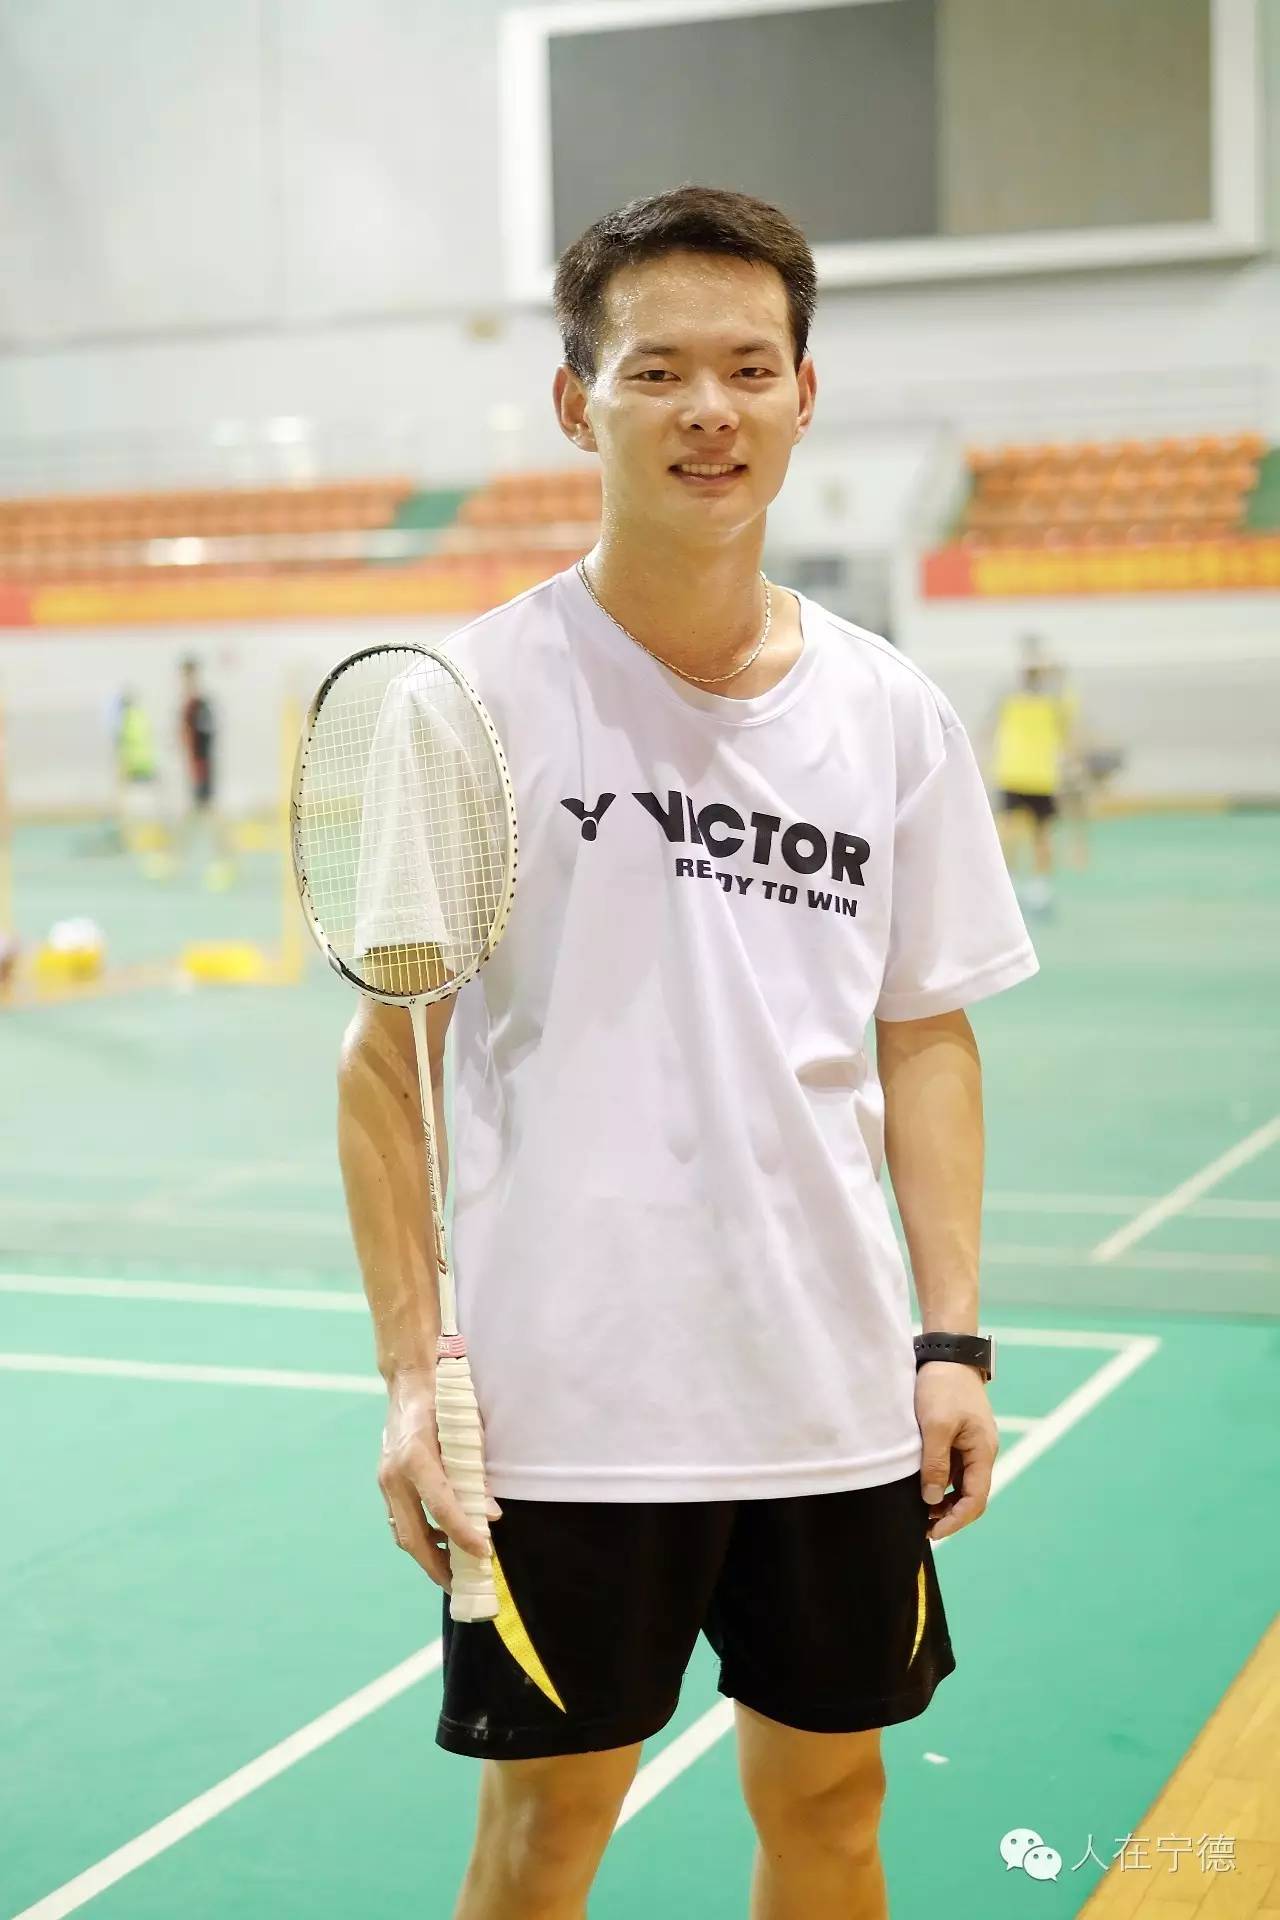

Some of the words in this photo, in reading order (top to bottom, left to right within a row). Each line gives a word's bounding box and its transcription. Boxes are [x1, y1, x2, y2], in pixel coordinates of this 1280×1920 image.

[632, 790, 871, 886] VICTOR
[675, 858, 755, 896] REDY
[762, 880, 798, 905] TO
[807, 889, 858, 918] WIN
